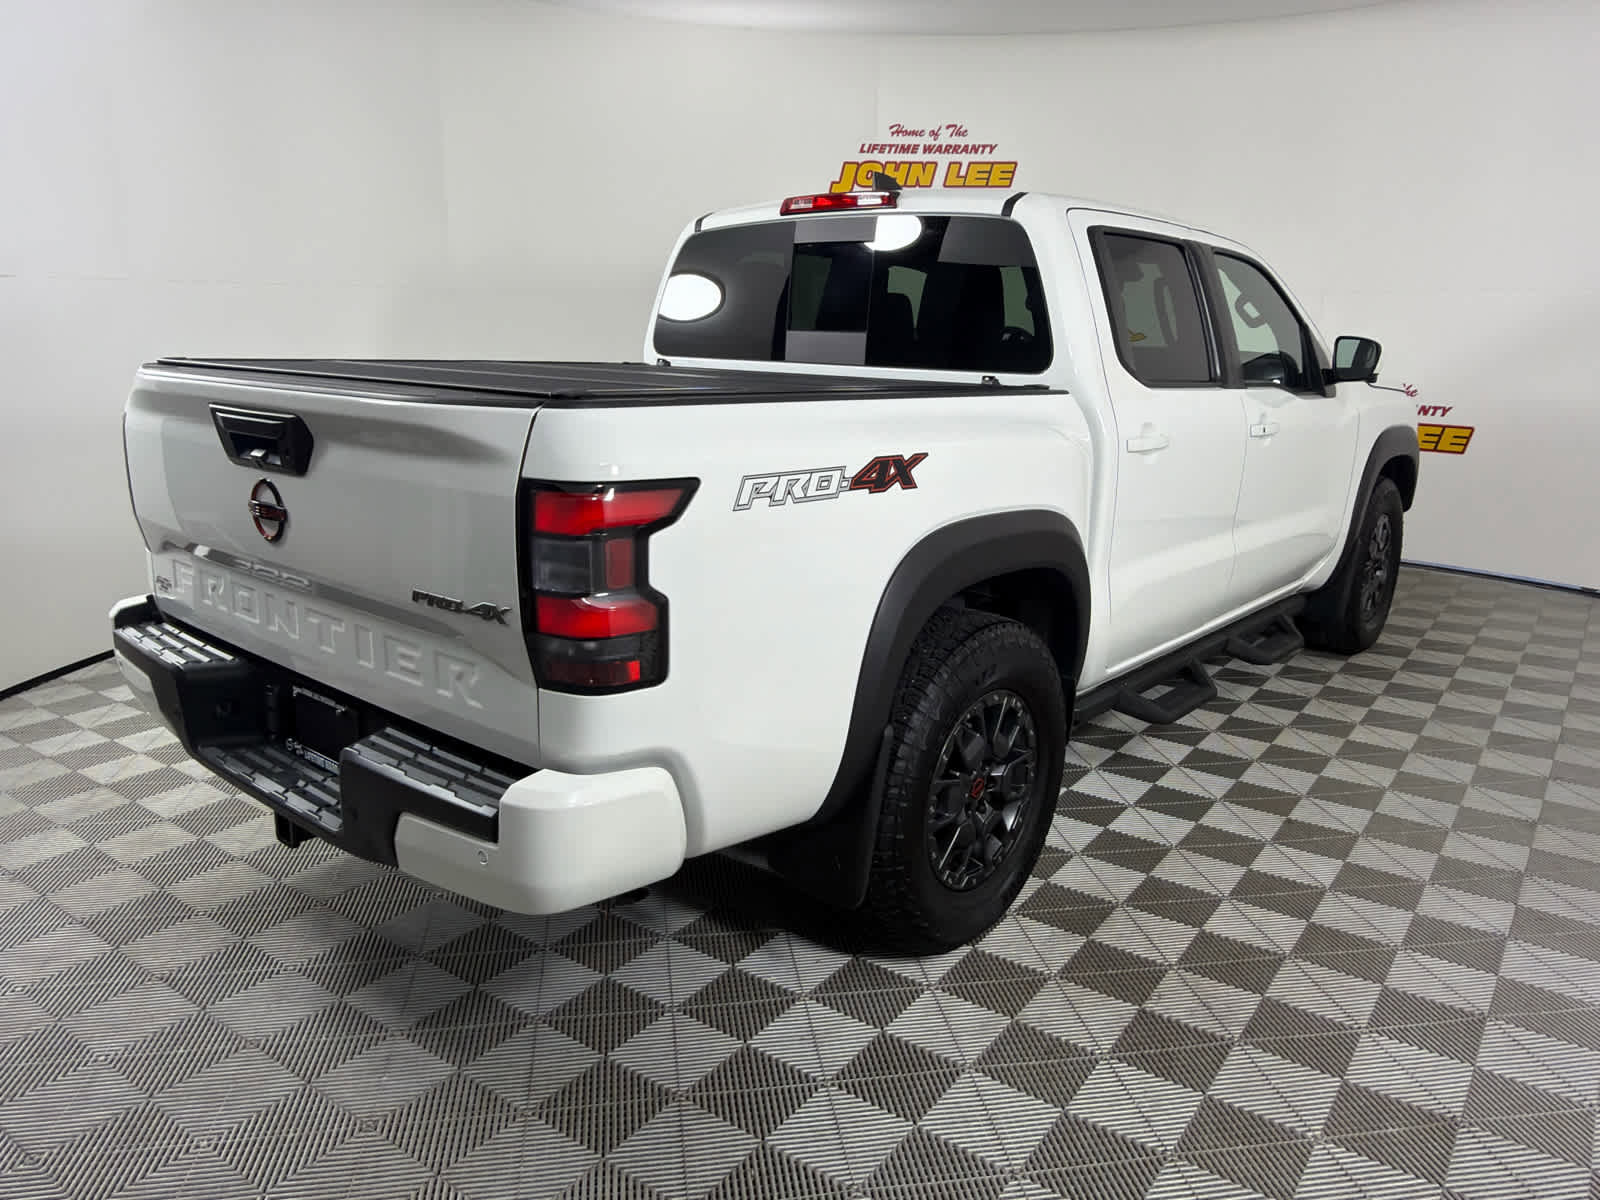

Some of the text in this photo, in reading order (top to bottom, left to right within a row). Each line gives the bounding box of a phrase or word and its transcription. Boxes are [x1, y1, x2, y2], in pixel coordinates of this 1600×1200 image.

[889, 123, 968, 140] Home of The
[859, 143, 998, 155] LIFETIME WARRANTY
[829, 161, 1018, 194] JOHN LEE
[1417, 423, 1475, 455] EE
[733, 452, 929, 511] PRO-4X
[172, 558, 484, 709] FRONTIER
